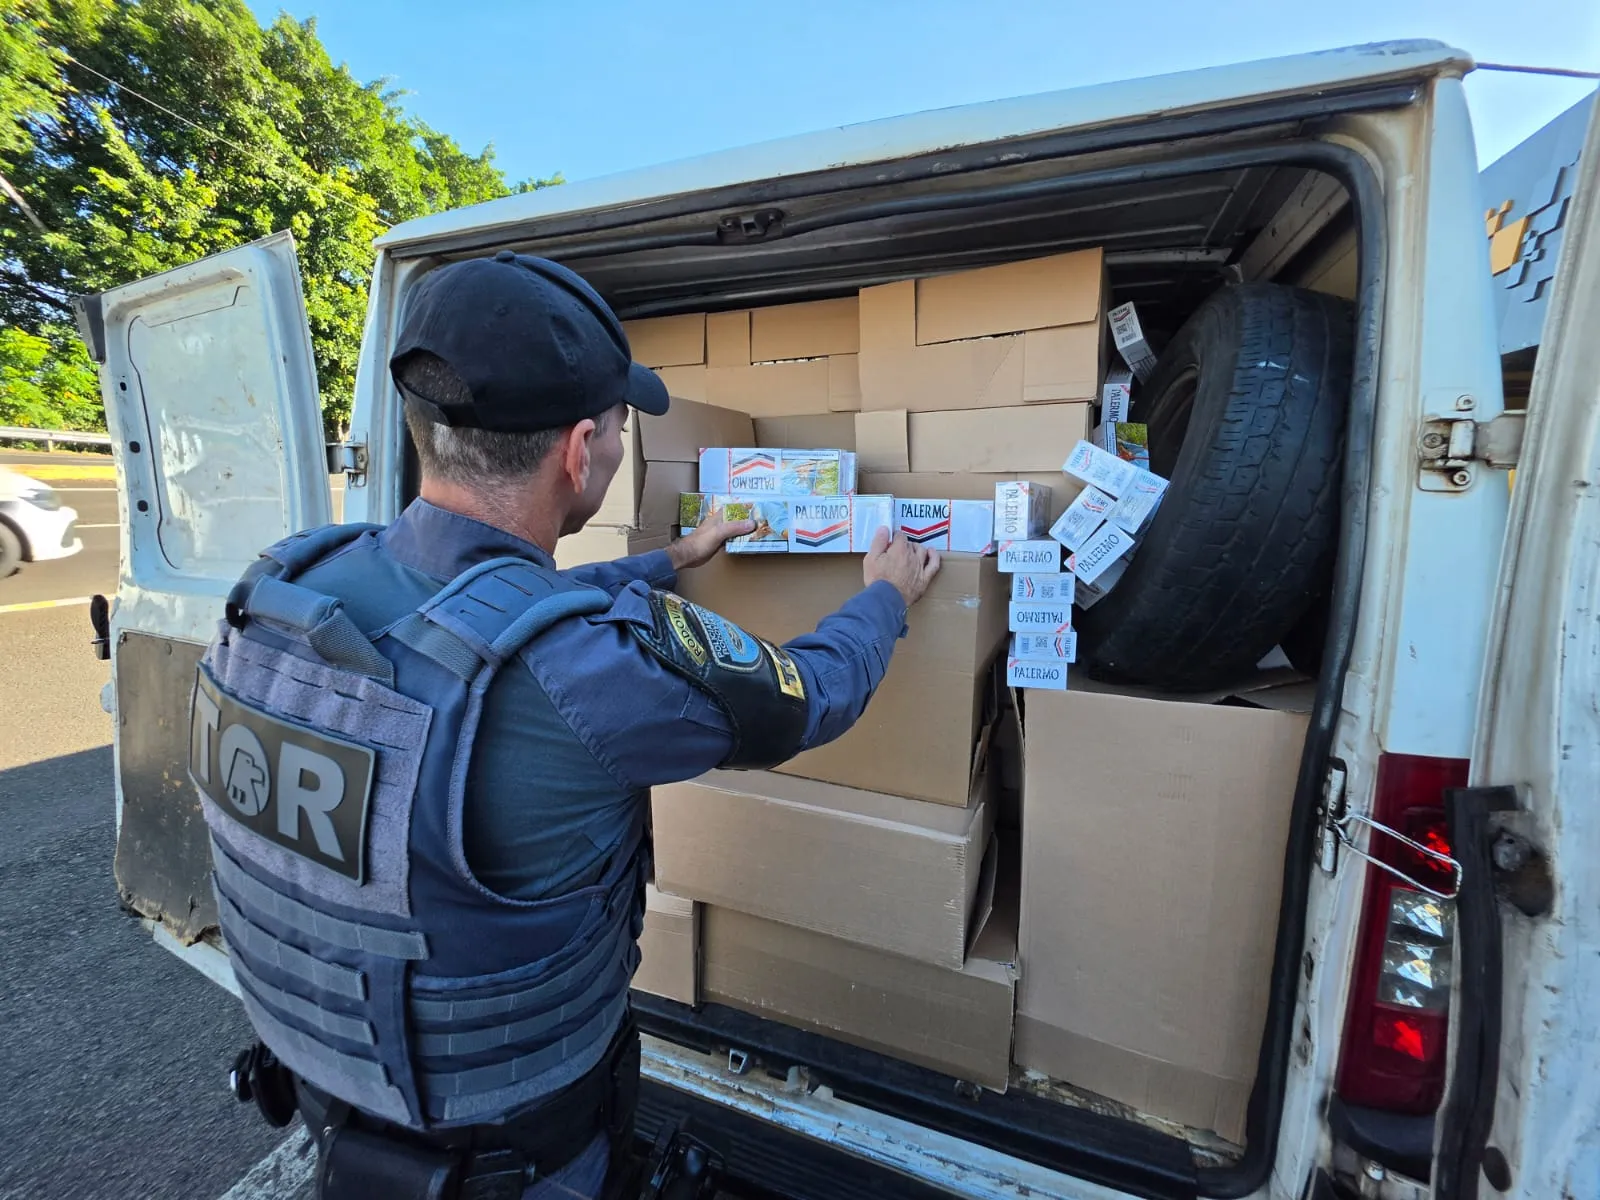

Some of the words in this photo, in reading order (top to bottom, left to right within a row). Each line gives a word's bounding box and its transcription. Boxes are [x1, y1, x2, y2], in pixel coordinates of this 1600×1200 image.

[1109, 389, 1122, 423] PALERMO
[732, 475, 775, 490] PALERMO
[796, 504, 849, 521] PALERMO
[901, 503, 950, 519] PALERMO
[1005, 488, 1018, 534] PALERMO
[1006, 550, 1053, 563] PALERMO
[1078, 533, 1120, 573] PALERMO
[1016, 611, 1063, 623] PALERMO
[1014, 666, 1060, 680] PALERMO
